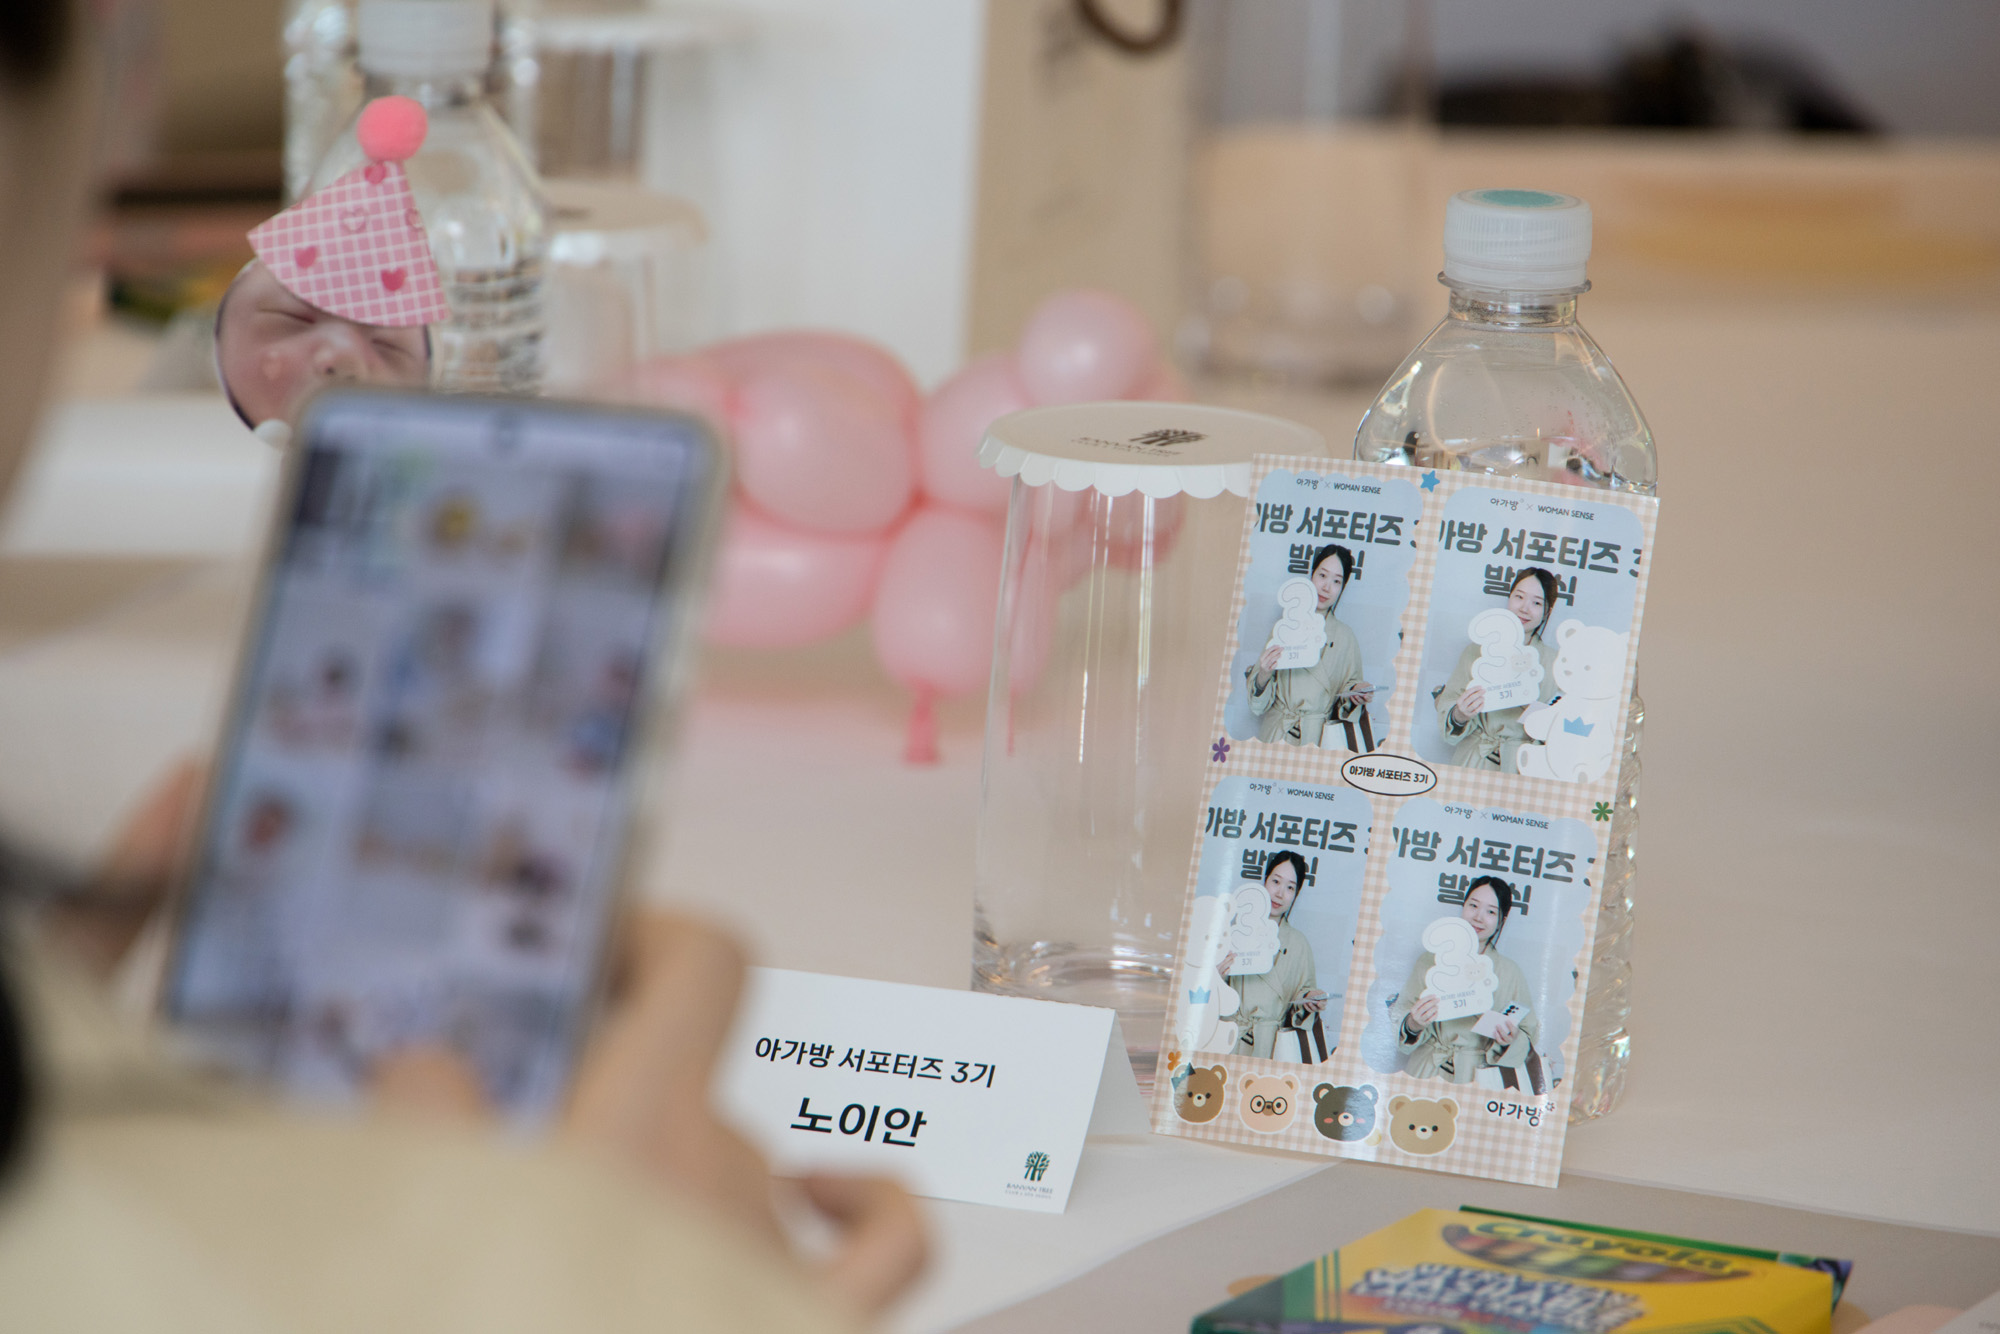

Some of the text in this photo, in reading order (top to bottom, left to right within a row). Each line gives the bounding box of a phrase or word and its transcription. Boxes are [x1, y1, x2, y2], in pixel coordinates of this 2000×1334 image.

[1296, 478, 1319, 490] 아가방
[1333, 482, 1361, 492] WOMAN
[1361, 485, 1381, 495] SENSE
[1490, 498, 1519, 511] 아가방
[1537, 504, 1570, 516] WOMAN
[1571, 509, 1595, 521] SENSE
[1295, 506, 1404, 546] 서포터즈
[1492, 527, 1622, 574] 서포터즈
[1349, 765, 1429, 784] 아가방 서포터즈 3기
[1249, 783, 1272, 795] 아가방
[1287, 788, 1314, 798] WOMAN
[1314, 791, 1335, 801] SENSE
[1444, 805, 1473, 820] 아가방
[1491, 813, 1524, 825] WOMAN
[1525, 818, 1550, 830] SENSE
[1249, 812, 1358, 853] 서포터즈
[1446, 835, 1576, 883] 서포터즈
[755, 1036, 996, 1088] 아가방 서포터즈 3기
[790, 1097, 928, 1148] 노이안
[1486, 1100, 1543, 1127] 아가방
